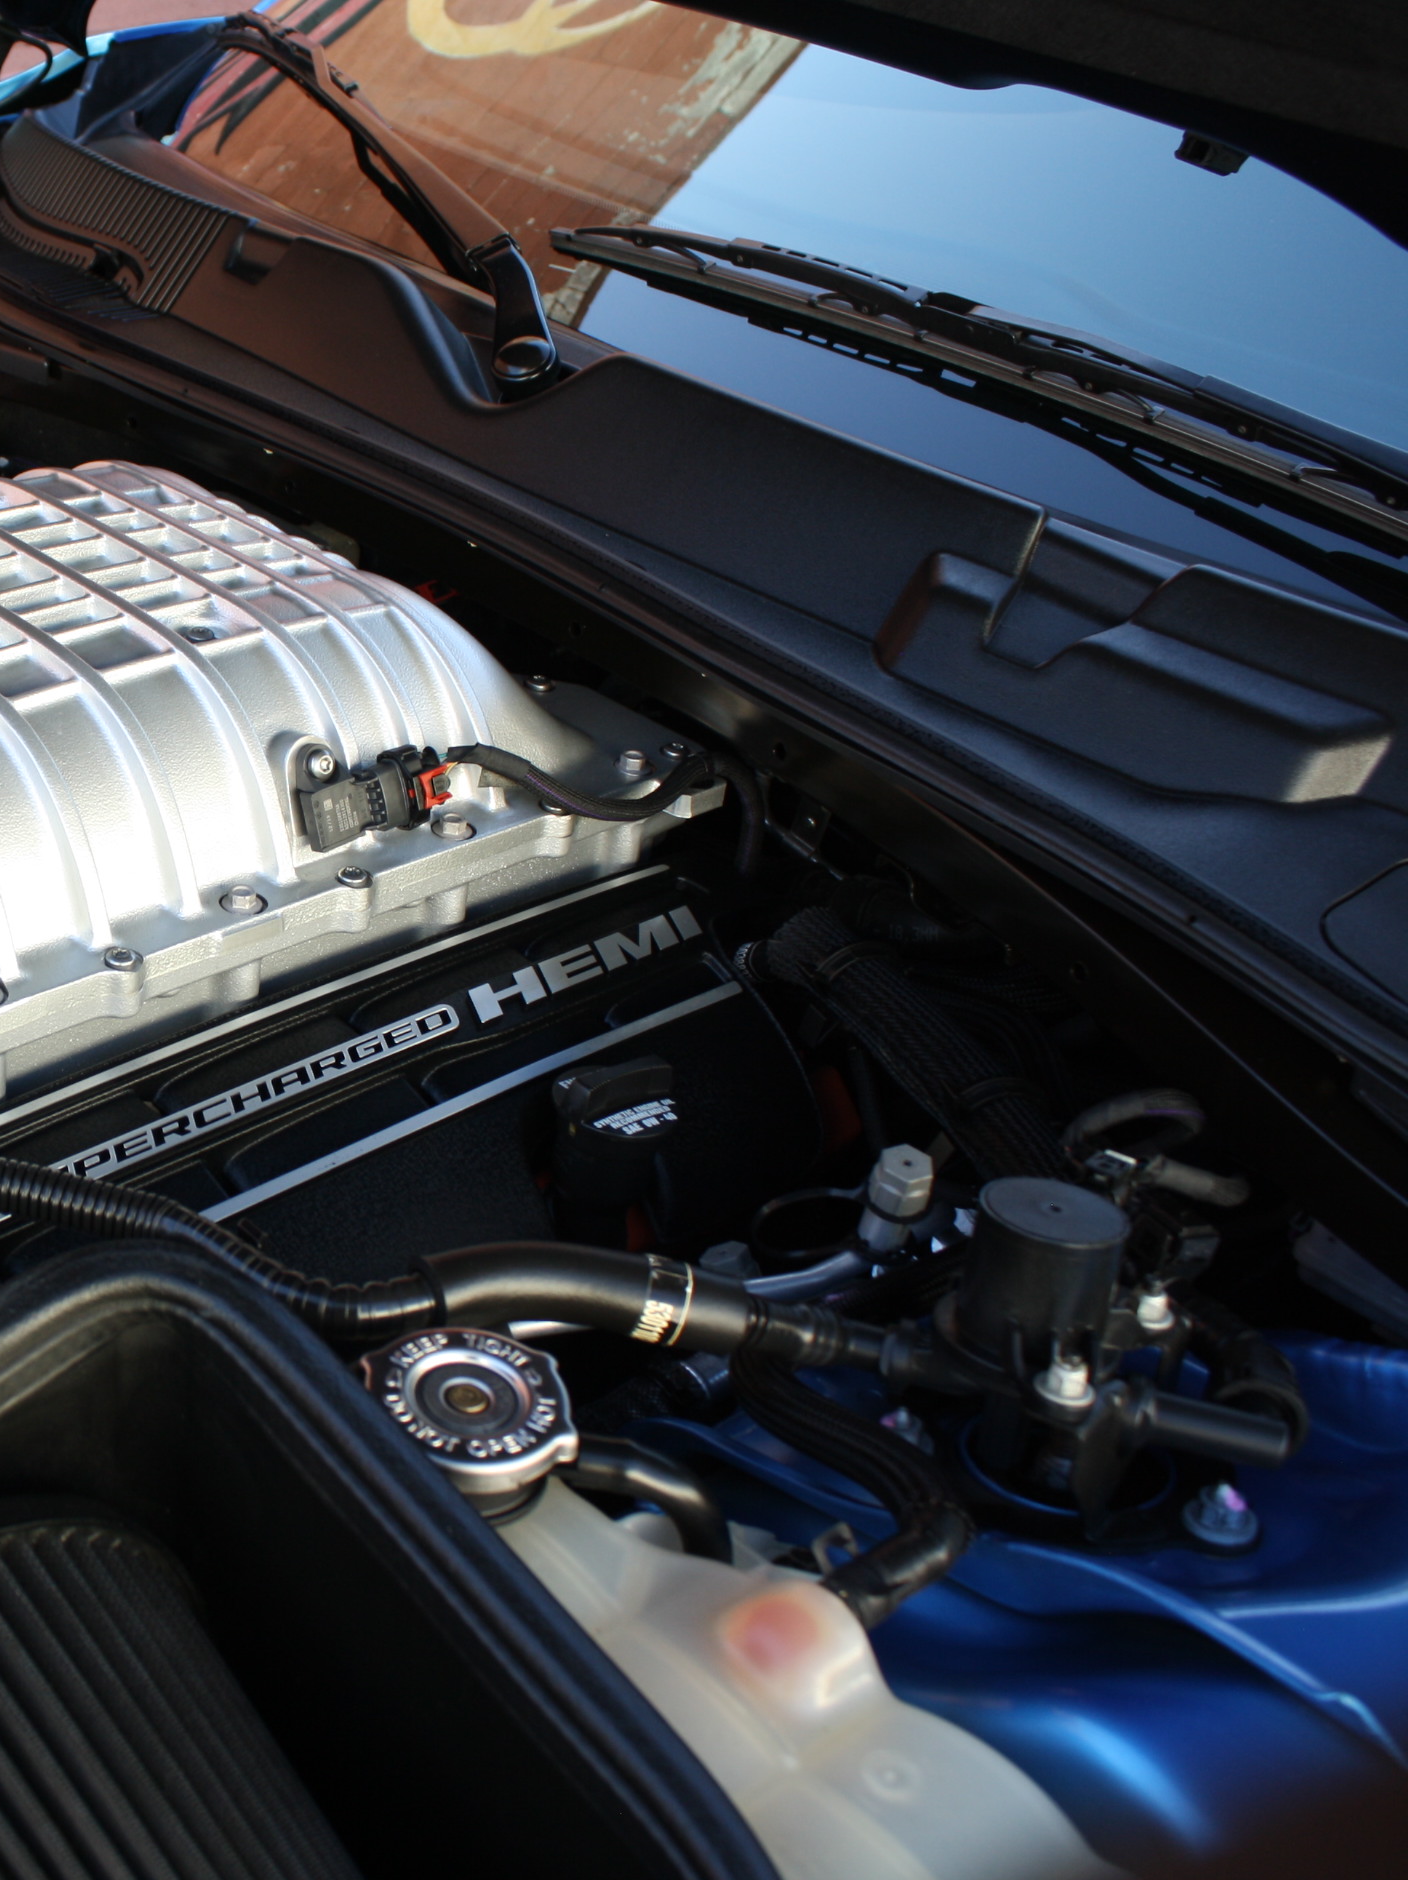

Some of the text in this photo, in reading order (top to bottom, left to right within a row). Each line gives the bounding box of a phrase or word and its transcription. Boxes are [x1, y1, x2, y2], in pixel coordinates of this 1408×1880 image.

[468, 905, 703, 1014] HEMI
[593, 1098, 676, 1128] SYNTHETIC ENGINE OIL
[611, 1106, 672, 1130] RECOMMENDED
[621, 1123, 644, 1135] SAE
[389, 1333, 532, 1368] KEEP TIGHT
[466, 1428, 537, 1458] OPEN
[524, 1398, 557, 1434] HOT
